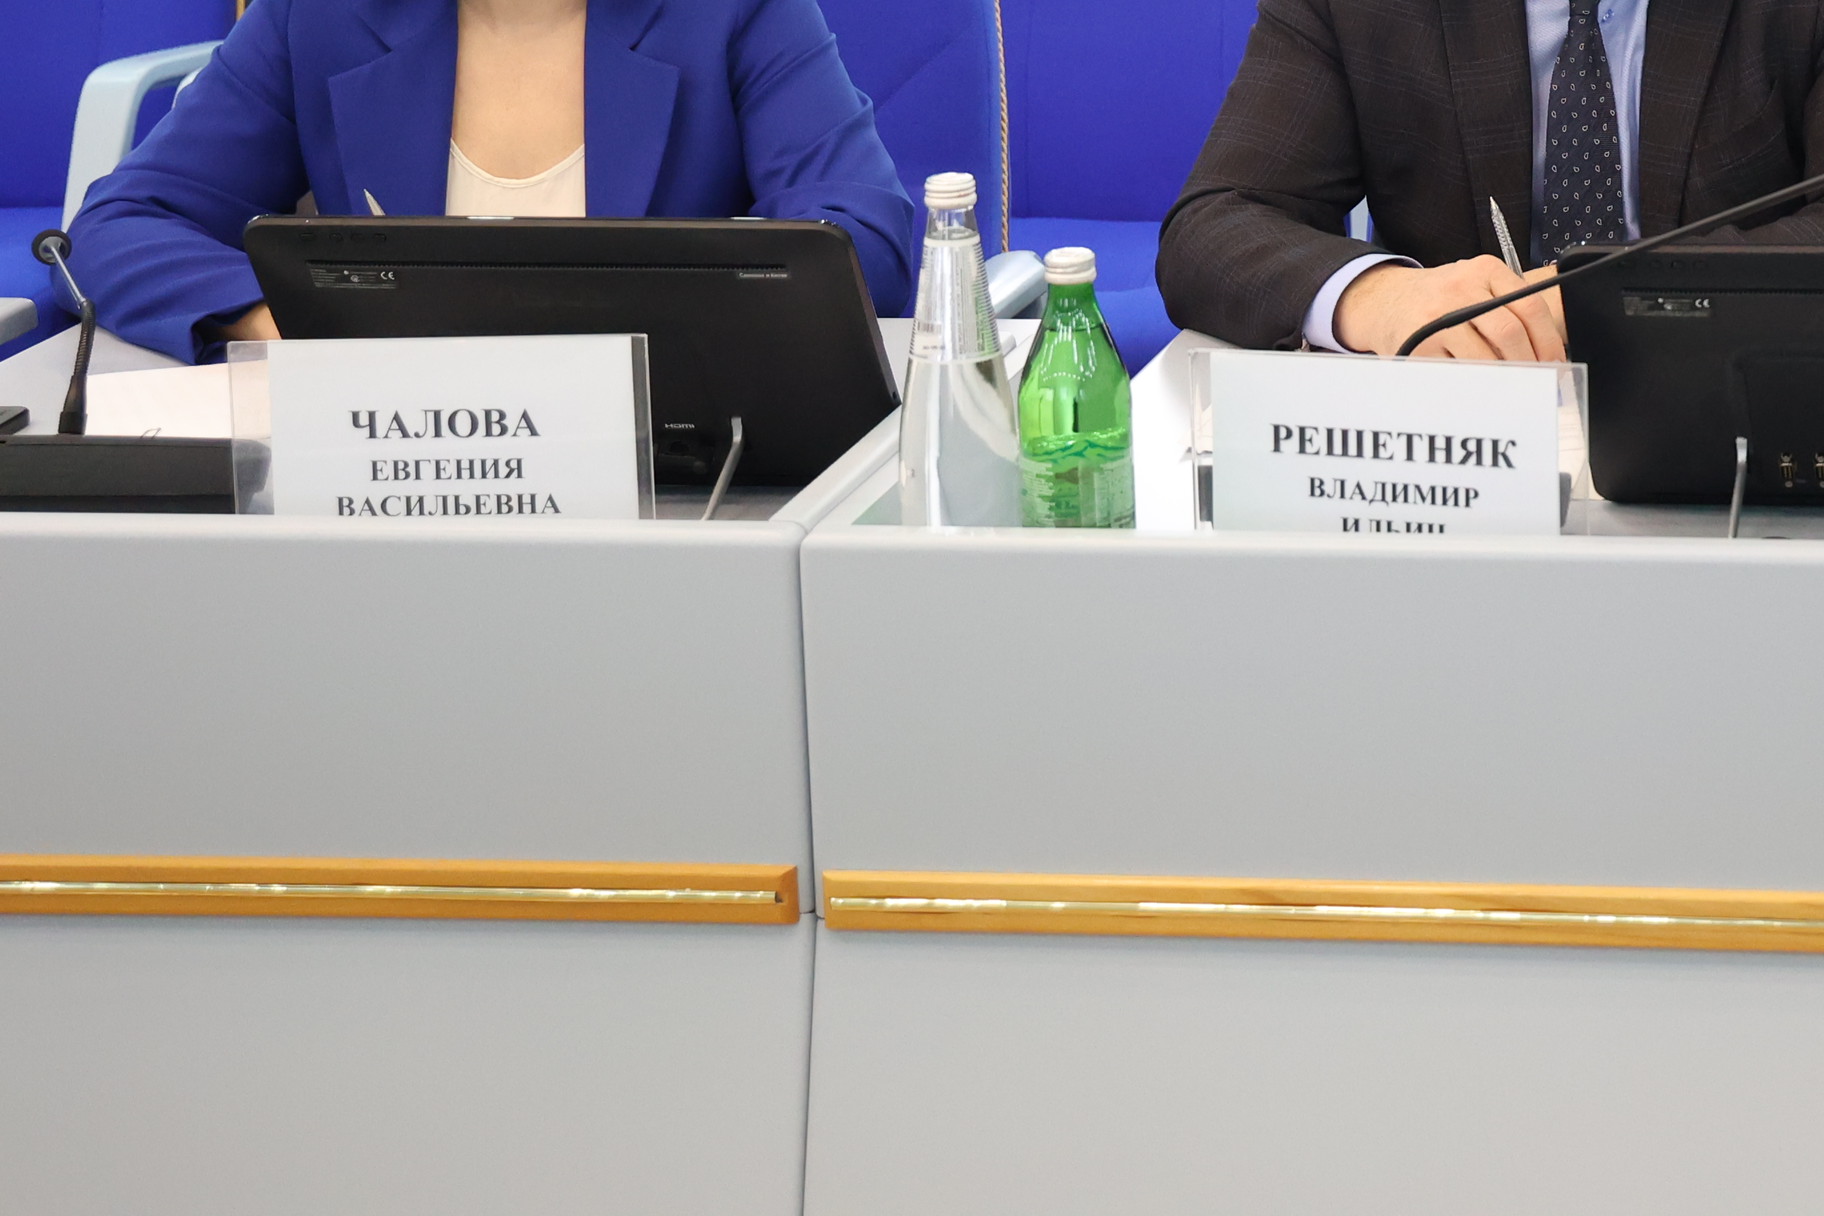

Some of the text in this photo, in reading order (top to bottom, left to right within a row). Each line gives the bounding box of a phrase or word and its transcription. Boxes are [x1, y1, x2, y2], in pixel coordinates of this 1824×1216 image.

[348, 408, 541, 439] ЧАЛОВА
[1270, 423, 1517, 469] РЕШЕТНЯК
[370, 457, 525, 481] ЕВГЕНИЯ
[336, 493, 562, 517] ВАСИЛЬЕВНА
[1307, 476, 1480, 509] ВЛАДИМИР
